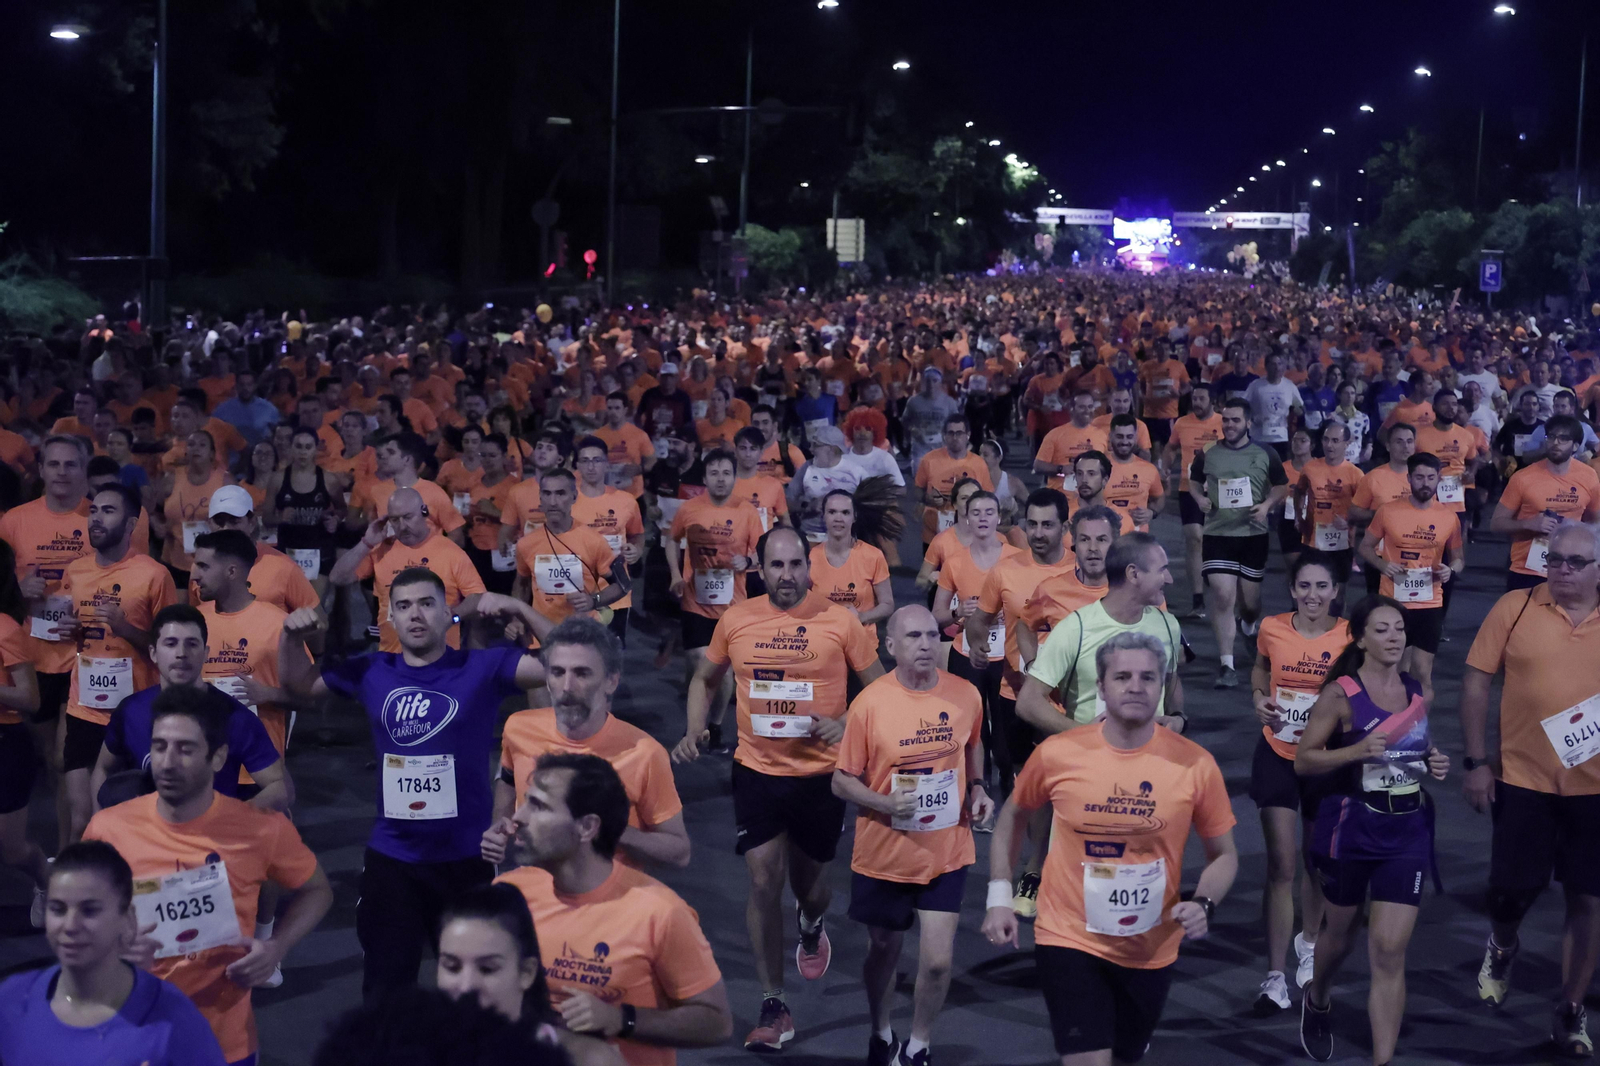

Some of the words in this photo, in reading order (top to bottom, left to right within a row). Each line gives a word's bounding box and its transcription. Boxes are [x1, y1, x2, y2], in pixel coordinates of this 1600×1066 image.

[1485, 264, 1497, 278] P
[1226, 488, 1243, 496] 7768
[548, 568, 571, 578] 7065
[705, 581, 724, 589] 2663
[1404, 580, 1424, 588] 6186
[1282, 665, 1312, 675] SEVILLA
[1297, 661, 1330, 670] NOCTURN
[90, 674, 117, 688] 8404
[395, 692, 431, 722] life
[766, 700, 796, 714] 1102
[1287, 708, 1310, 723] 104
[392, 721, 431, 738] CARREFOUR
[916, 727, 953, 736] NOCTURNA
[899, 736, 933, 746] SEVILLA
[397, 777, 441, 793] 17843
[918, 791, 948, 808] 1849
[1107, 796, 1156, 807] NOCTURNA
[1084, 804, 1127, 814] SEVILLA
[1109, 888, 1149, 906] 4012
[155, 894, 214, 922] 16235
[553, 958, 612, 974] NOCTURNA
[544, 968, 577, 982] VILLA
